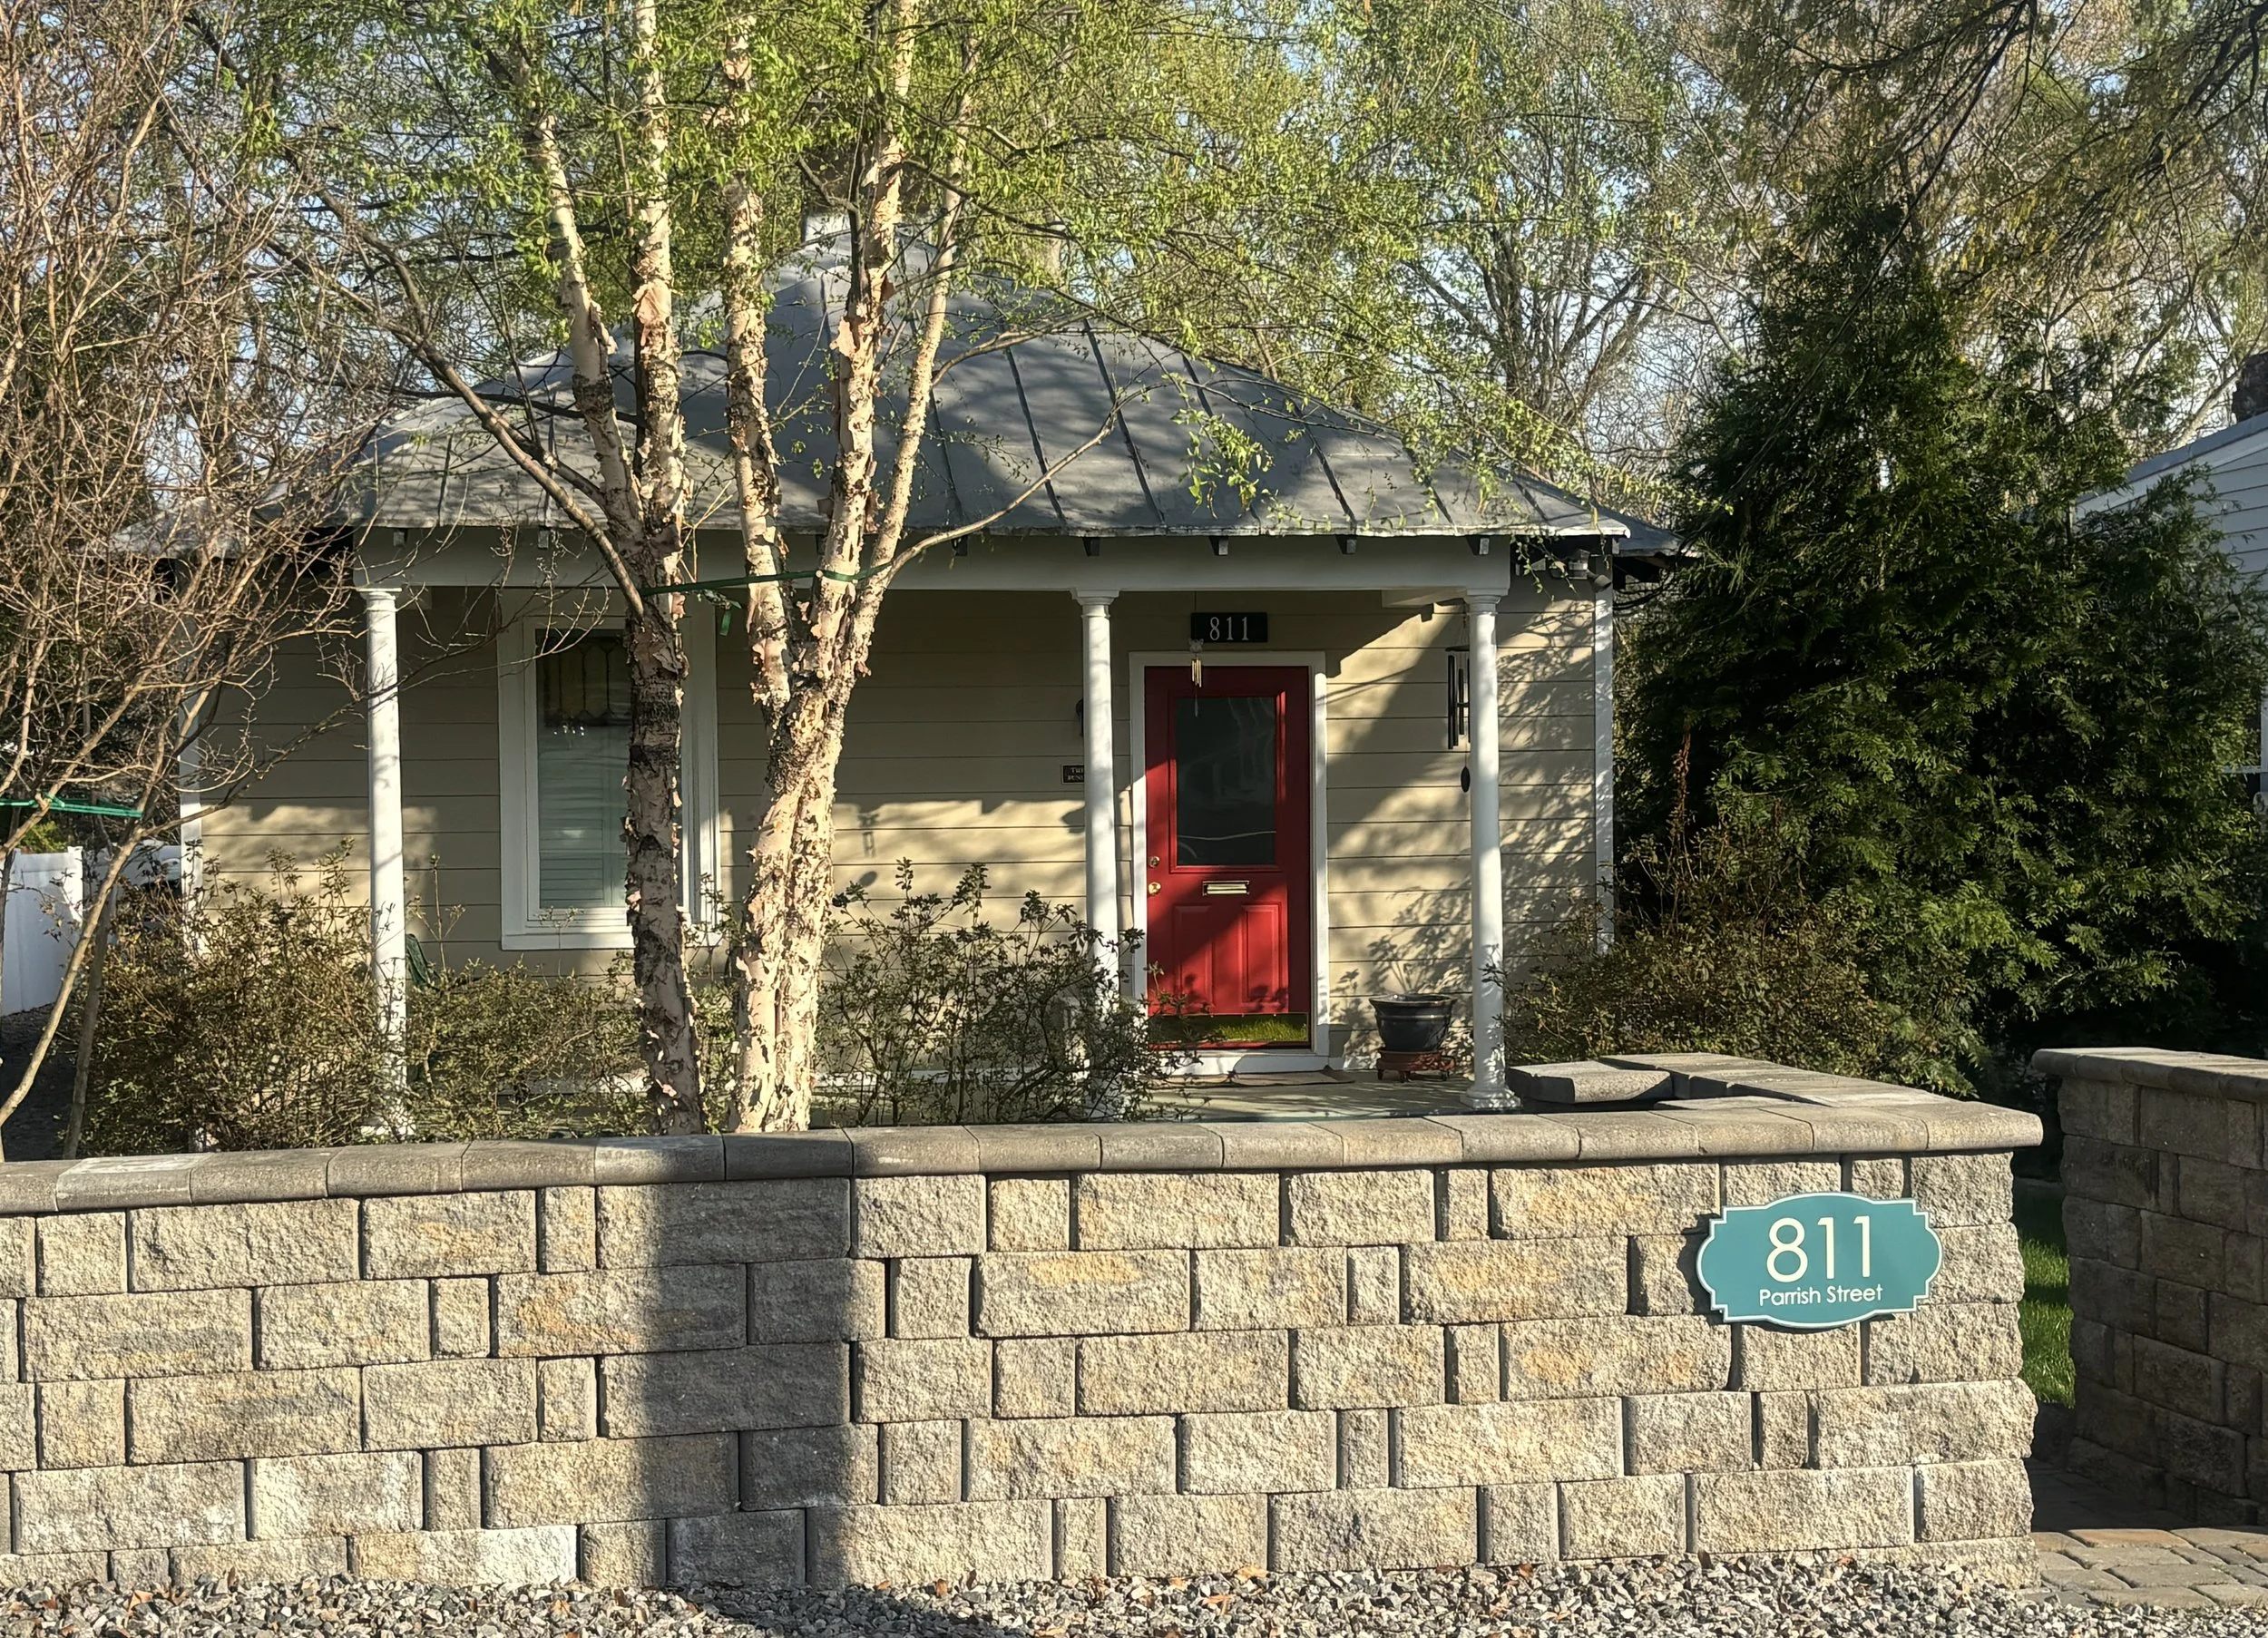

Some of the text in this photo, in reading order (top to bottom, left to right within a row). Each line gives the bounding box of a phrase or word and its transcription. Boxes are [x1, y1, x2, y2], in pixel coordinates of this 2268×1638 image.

[1209, 617, 1249, 640] 811
[1766, 1215, 1871, 1282] 811
[1759, 1283, 1883, 1307] Parrish Street
